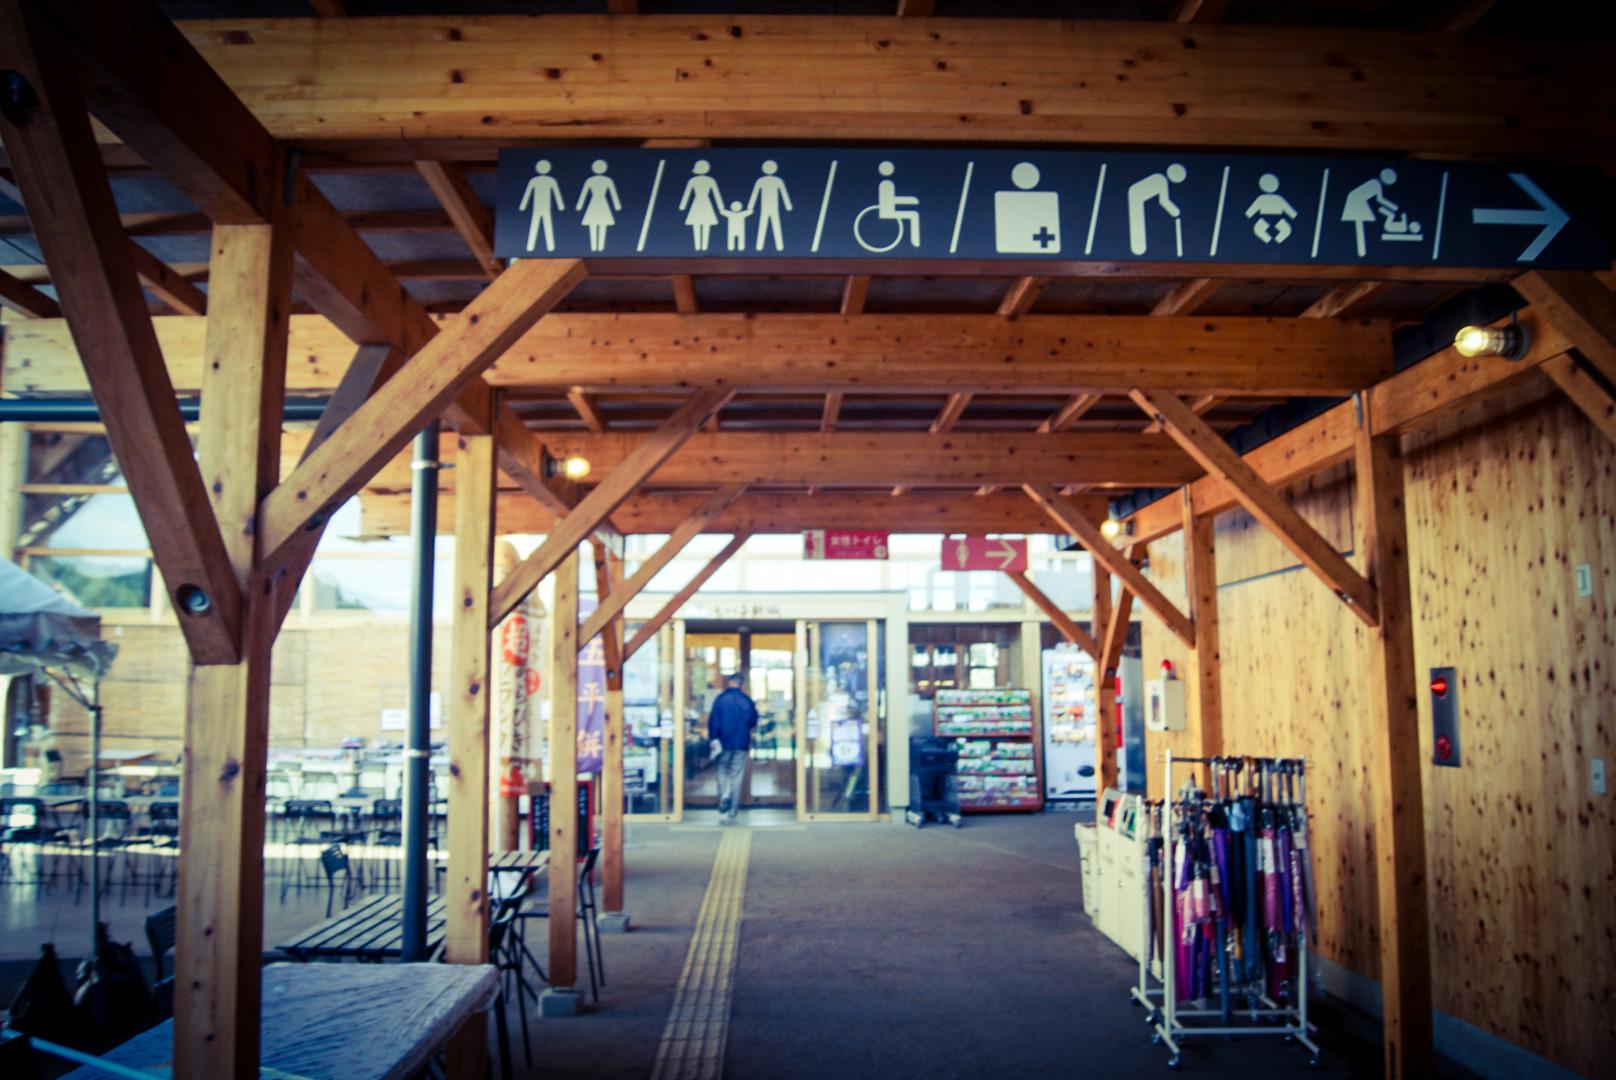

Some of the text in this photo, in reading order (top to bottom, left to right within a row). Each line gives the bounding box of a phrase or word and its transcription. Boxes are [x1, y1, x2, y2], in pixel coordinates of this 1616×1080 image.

[830, 535, 882, 547] 女性トイレ
